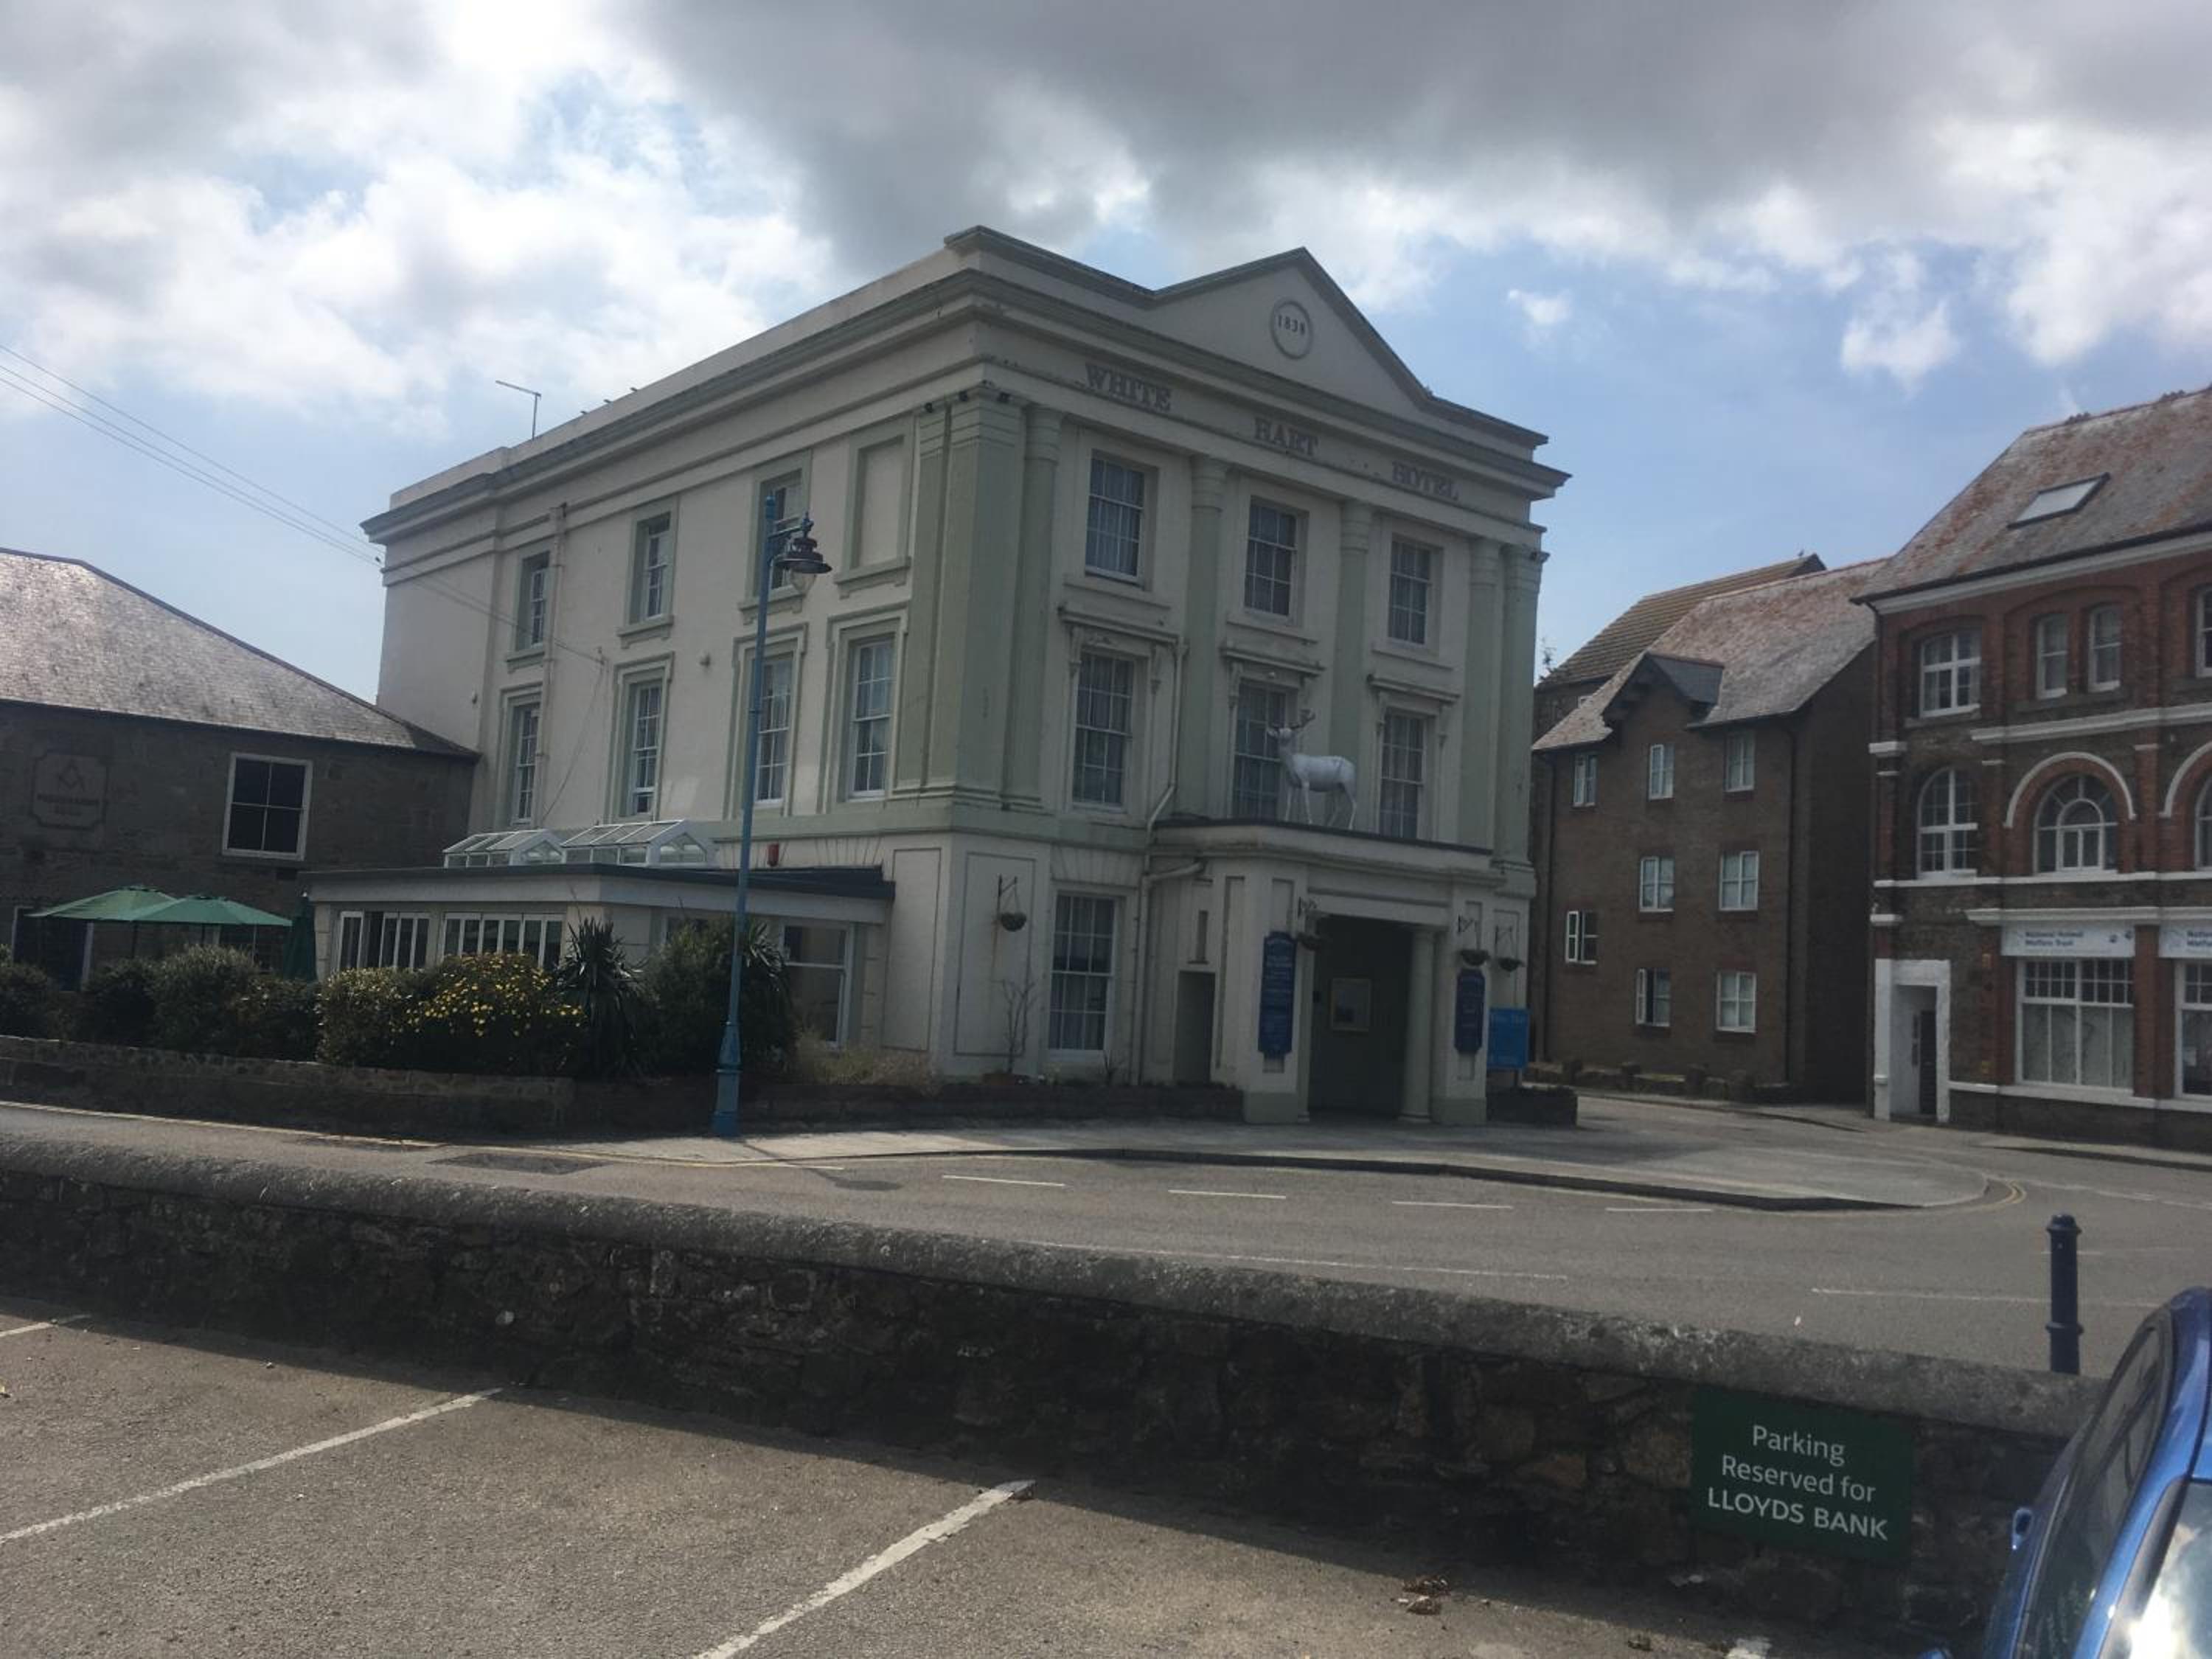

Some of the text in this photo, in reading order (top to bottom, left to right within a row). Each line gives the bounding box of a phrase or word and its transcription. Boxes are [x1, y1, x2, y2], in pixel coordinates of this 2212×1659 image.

[1085, 364, 1458, 501] WHITE HART HOTEL
[1753, 1425, 1845, 1467] Parking
[1722, 1455, 1877, 1502] Reserved for
[1708, 1486, 1888, 1541] LLOYDS BANK
